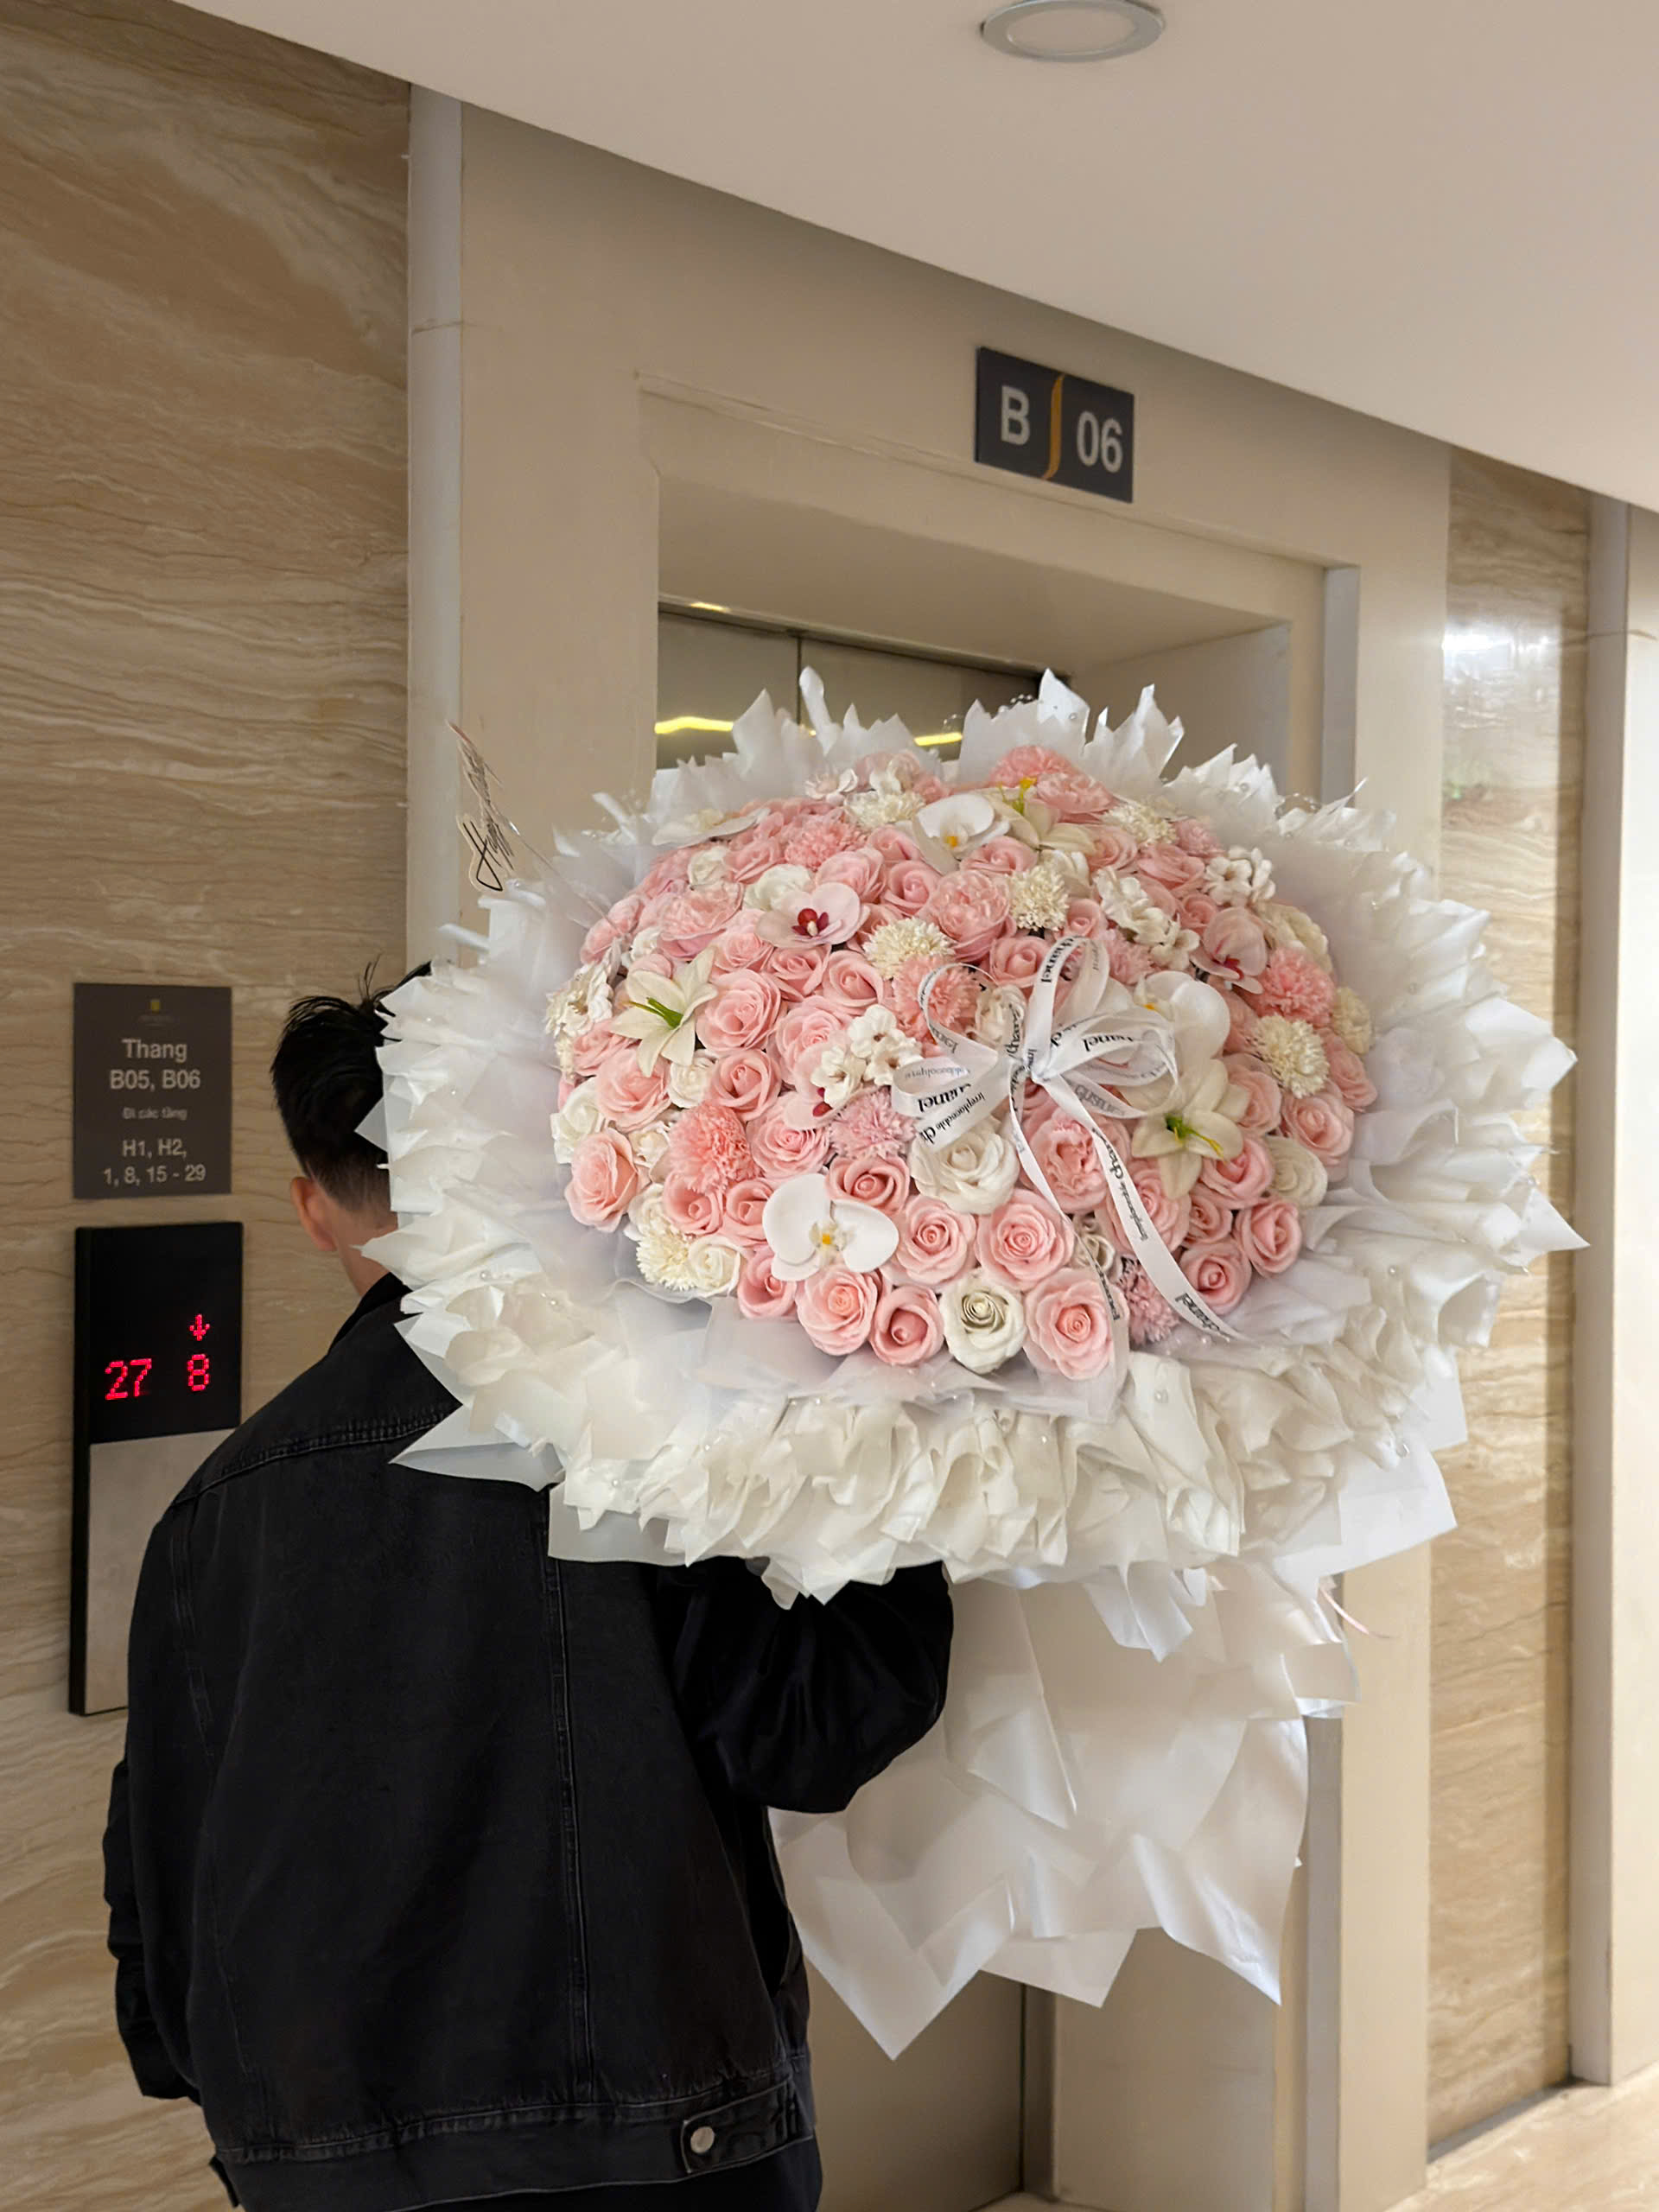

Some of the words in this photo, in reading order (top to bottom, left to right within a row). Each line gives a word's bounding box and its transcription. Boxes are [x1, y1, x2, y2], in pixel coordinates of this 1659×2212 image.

[1001, 385, 1031, 446] B
[1077, 410, 1123, 473] 06
[122, 1039, 188, 1063] Thang
[1084, 1034, 1134, 1052] anel
[110, 1070, 156, 1091] B05,
[162, 1069, 200, 1089] B06
[122, 1139, 152, 1159] H1,
[158, 1138, 188, 1158] H2,
[104, 1167, 119, 1187] 1,
[124, 1166, 141, 1185] 8,
[146, 1166, 167, 1183] 15
[185, 1164, 207, 1181] 29
[105, 1357, 152, 1400] 27
[187, 1353, 210, 1391] 8
